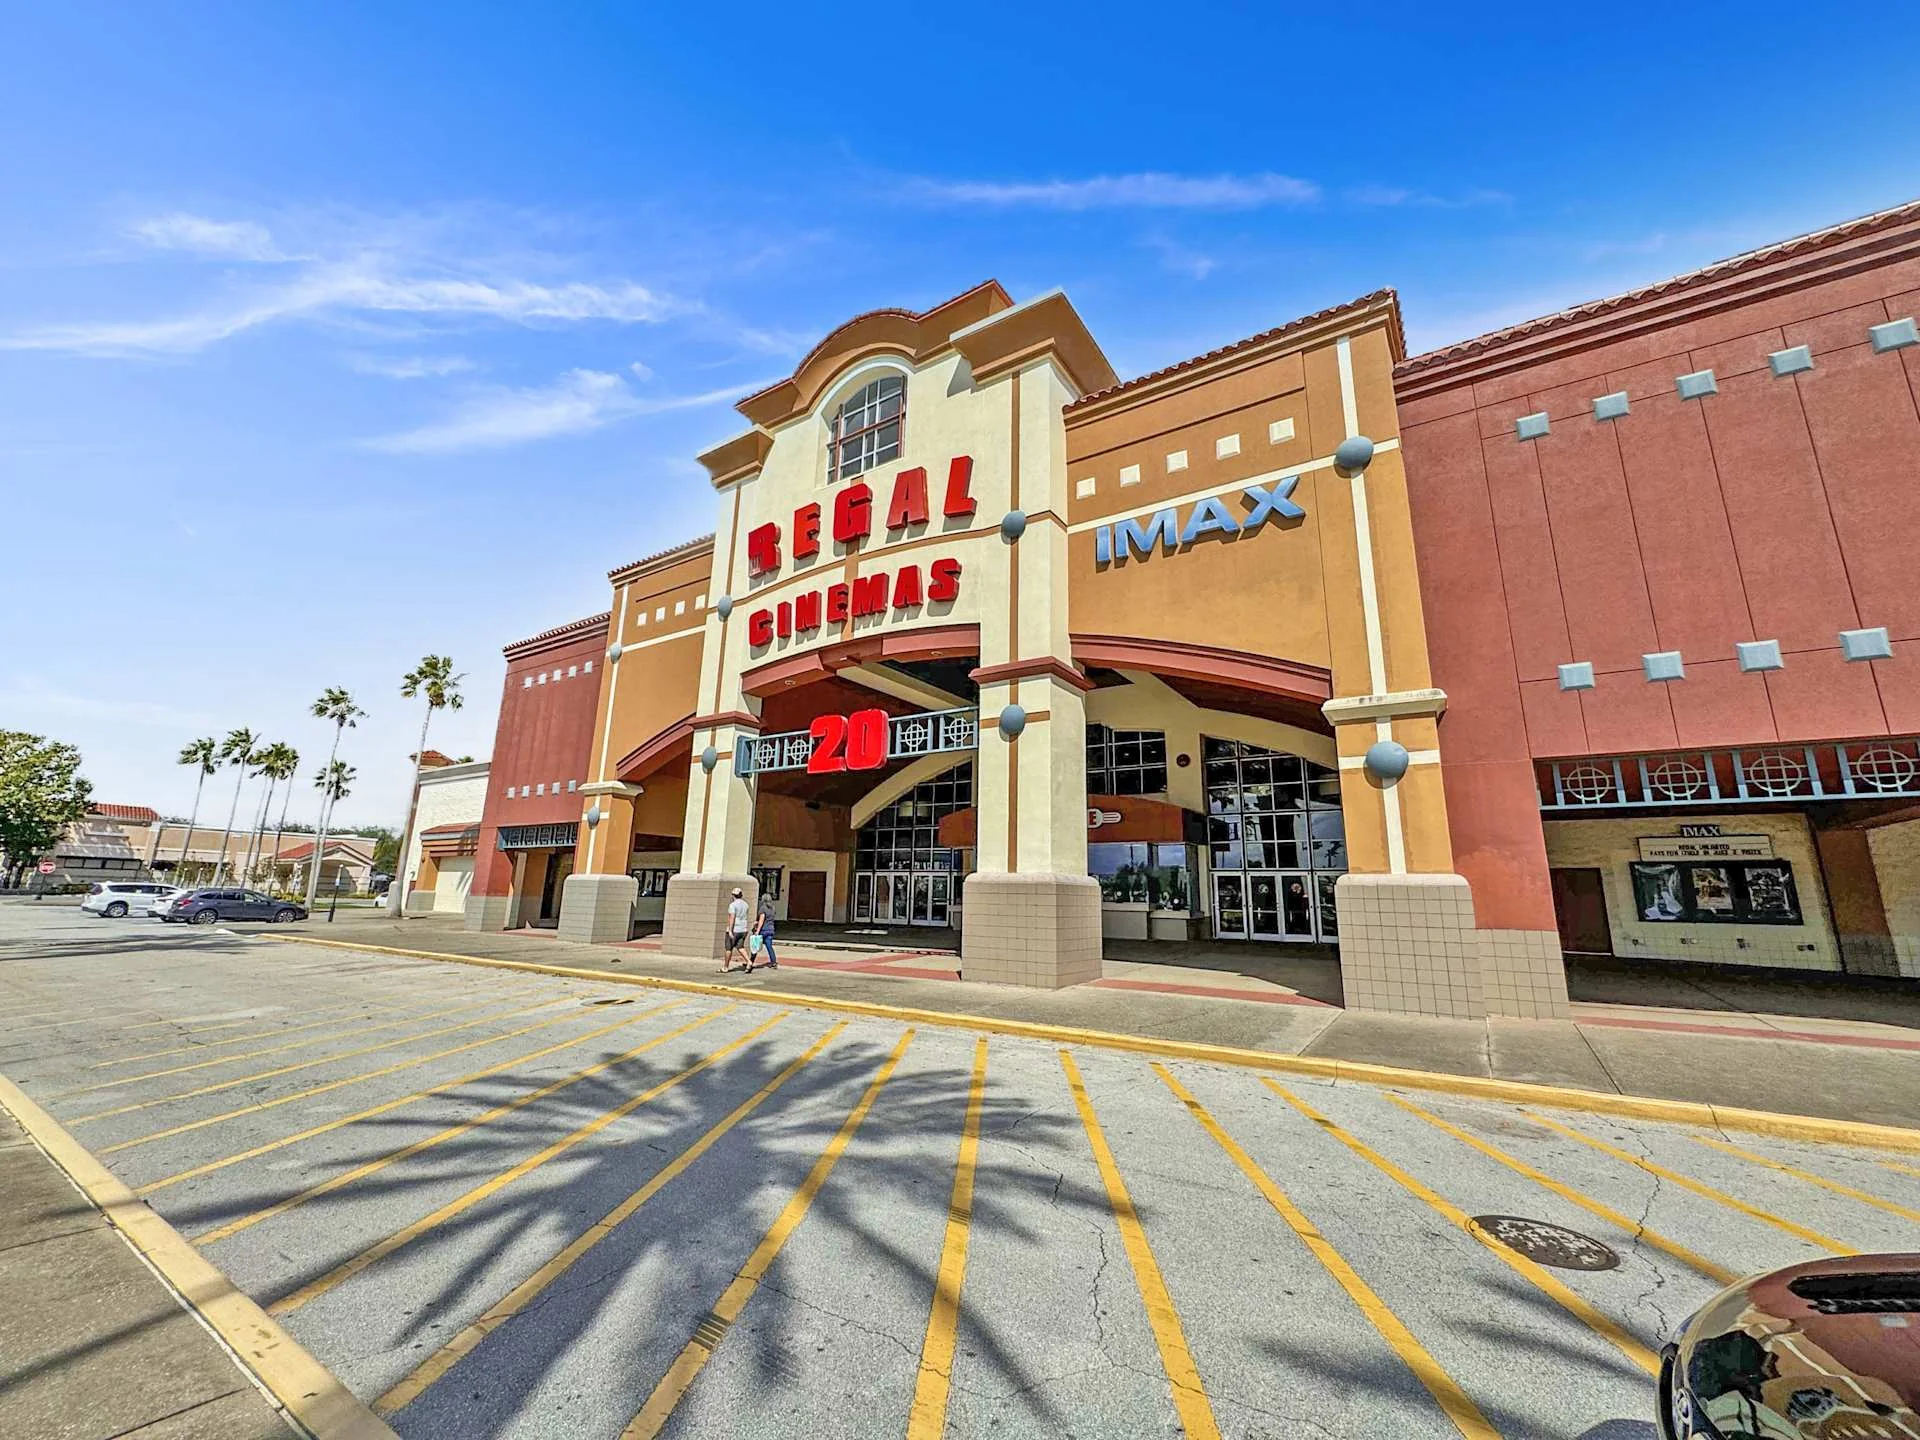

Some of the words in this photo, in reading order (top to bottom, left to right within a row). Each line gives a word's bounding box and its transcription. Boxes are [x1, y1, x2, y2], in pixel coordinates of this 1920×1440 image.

[748, 455, 977, 579] REGAL
[1096, 475, 1305, 563] IMAX
[749, 558, 962, 647] CINEMAS
[807, 709, 890, 774] 20
[1682, 826, 1720, 837] IMAX
